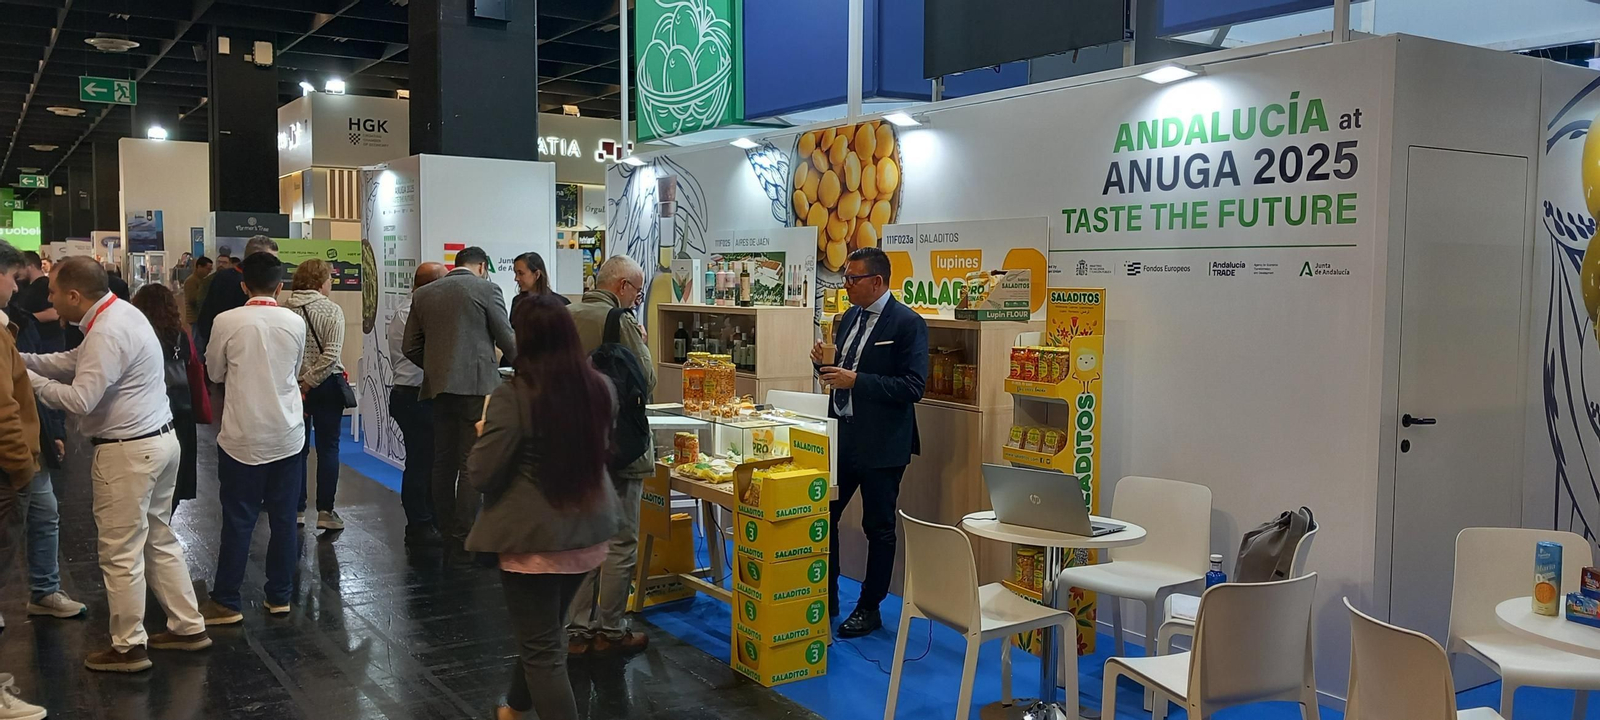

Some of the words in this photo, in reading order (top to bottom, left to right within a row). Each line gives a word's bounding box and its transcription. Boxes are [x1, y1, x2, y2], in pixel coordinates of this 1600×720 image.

[349, 117, 389, 134] HGK
[1113, 91, 1330, 154] ANDALUCÍA
[1339, 108, 1362, 131] at
[1102, 151, 1241, 195] ANUGA
[1253, 140, 1359, 185] 2025
[1062, 205, 1142, 234] TASTE
[1150, 201, 1208, 231] THE
[1218, 193, 1358, 229] FUTURE
[886, 235, 914, 244] 111F023a
[919, 232, 959, 243] SALADITOS
[936, 254, 979, 270] lupines
[1164, 264, 1191, 273] Europeos
[1212, 261, 1246, 269] Andalucía
[1212, 269, 1236, 277] TRADE
[1051, 291, 1100, 303] SALADITOS
[986, 311, 1006, 319] Lupin
[793, 440, 824, 455] SALADITOS
[814, 486, 821, 500] 3
[738, 505, 764, 518] SALADITOS
[776, 505, 812, 518] SALADITOS
[749, 528, 754, 540] 3
[815, 527, 822, 540] 3
[738, 545, 763, 559] SALADITOS
[775, 546, 812, 559] SALADITOS
[751, 568, 758, 579] 3
[813, 568, 821, 582] 3
[737, 582, 762, 600] SALADITOS
[773, 587, 811, 601] SALADITOS
[748, 607, 754, 619] 3
[812, 609, 819, 622] 3
[737, 623, 761, 641] SALADITOS
[773, 628, 809, 643] SALADITOS
[811, 649, 819, 663] 3
[736, 663, 761, 681] SALADITOS
[772, 669, 808, 683] SALADITOS
